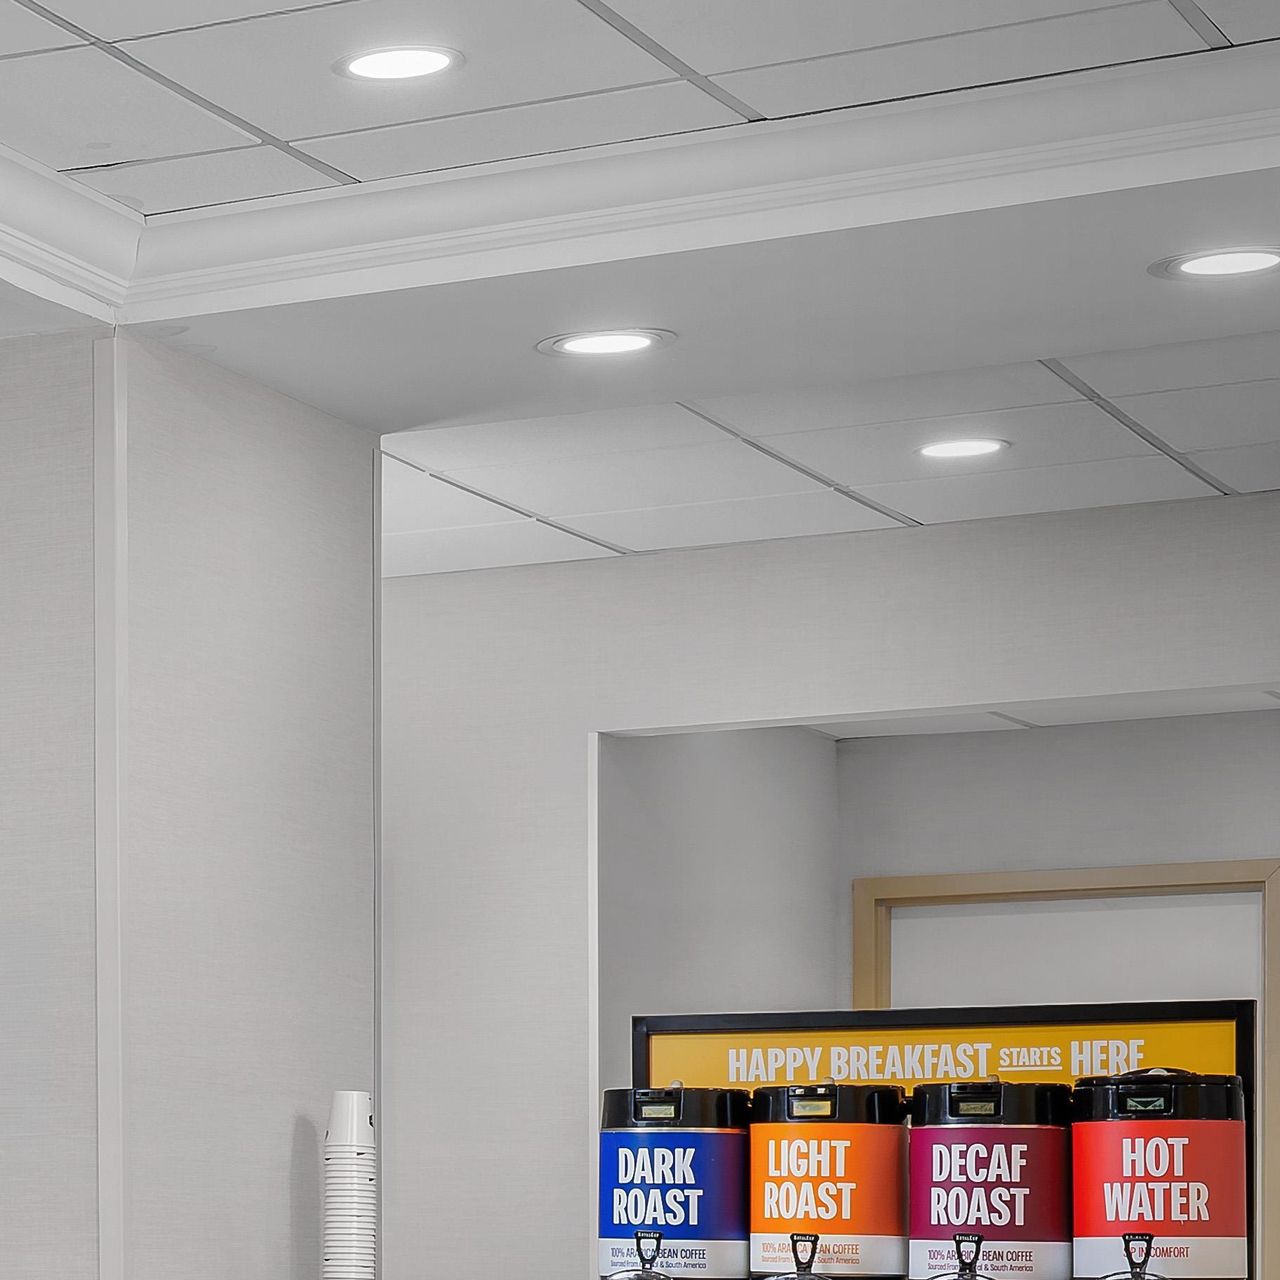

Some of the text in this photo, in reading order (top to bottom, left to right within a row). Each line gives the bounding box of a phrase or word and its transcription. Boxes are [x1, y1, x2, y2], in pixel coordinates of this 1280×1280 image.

[728, 1047, 822, 1082] HAPPY
[830, 1043, 992, 1080] BREAKFAST
[999, 1047, 1062, 1065] STARTS
[618, 1148, 695, 1184] DARK
[768, 1140, 850, 1177] LIGHT
[933, 1144, 1027, 1182] DECAF
[1122, 1137, 1189, 1177] HOT
[613, 1188, 703, 1225] ROAST
[764, 1182, 856, 1220] ROAST
[931, 1187, 1030, 1226] ROAST
[1104, 1182, 1210, 1221] WATER
[611, 1248, 624, 1257] 100%
[659, 1249, 678, 1259] BEAN
[680, 1249, 706, 1259] COFFEE
[683, 1261, 706, 1269] America
[762, 1243, 776, 1253] 100%
[833, 1244, 859, 1254] COFFEE
[928, 1250, 945, 1260] 100%
[982, 1251, 1003, 1261] BEAN
[1006, 1251, 1033, 1262] COFFEE
[1151, 1247, 1189, 1257] COMFORT
